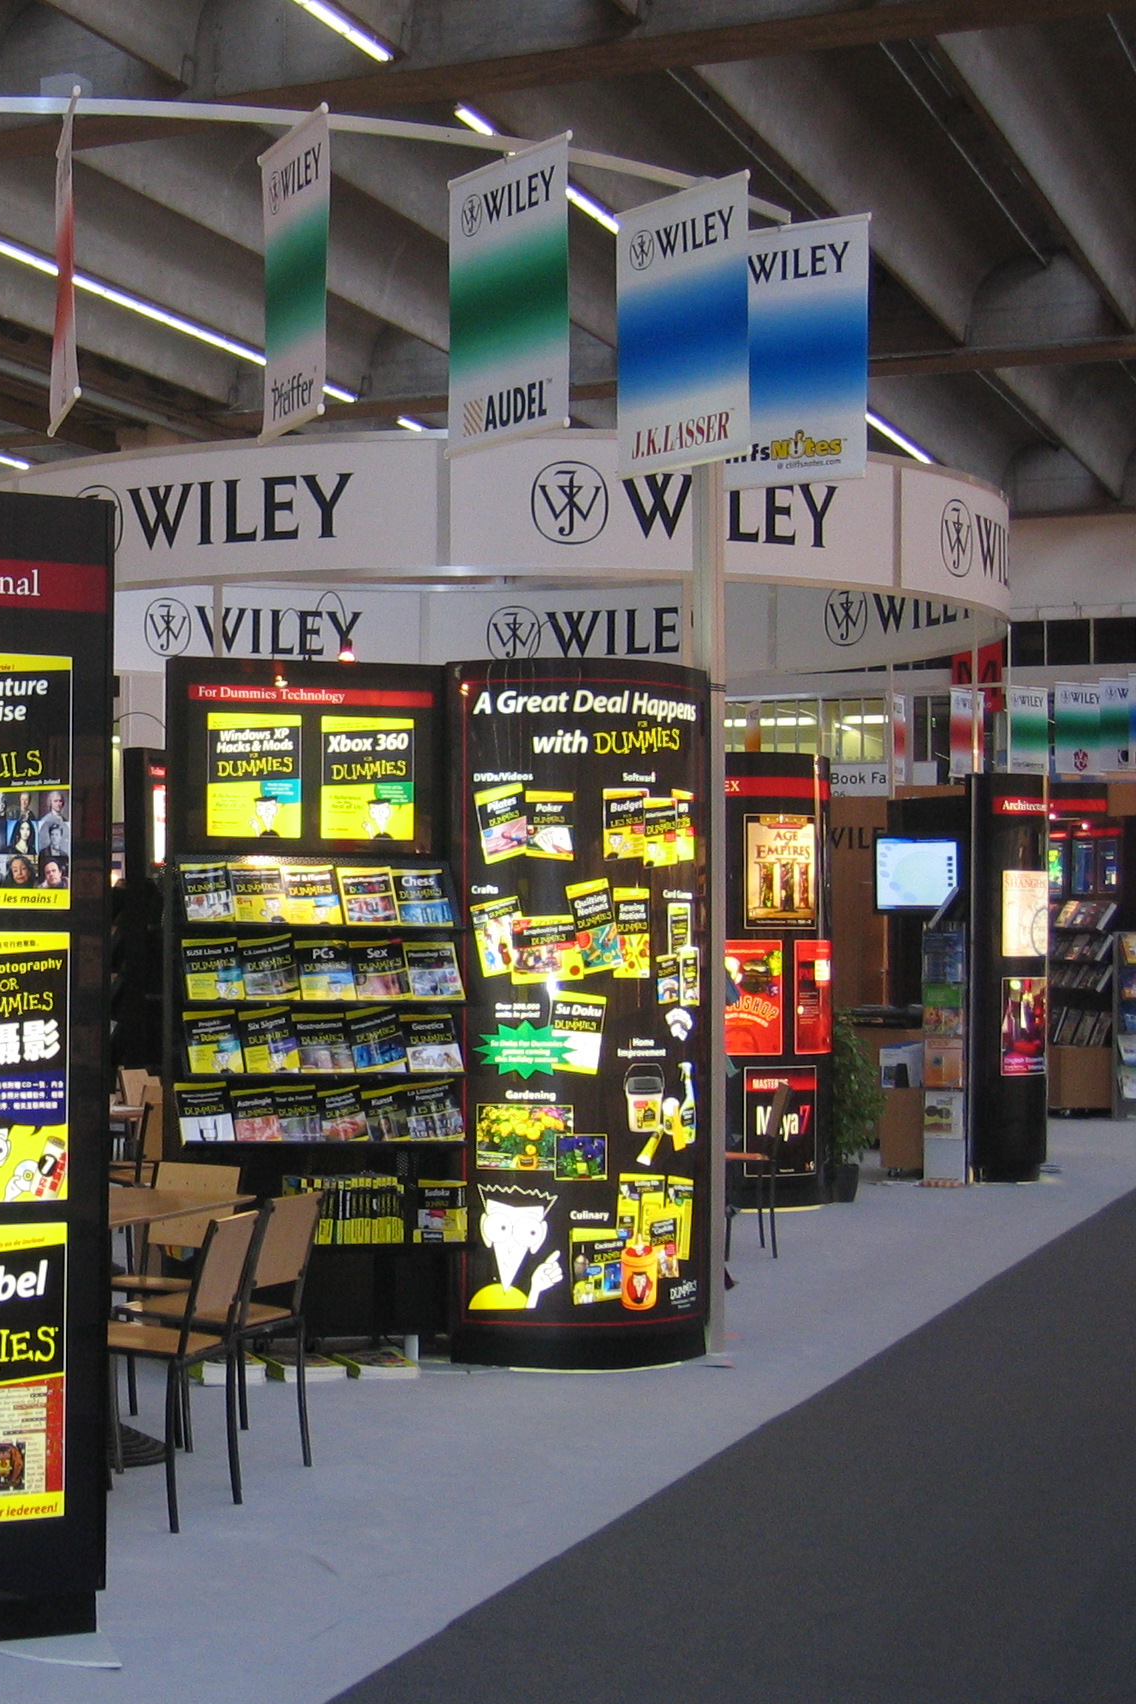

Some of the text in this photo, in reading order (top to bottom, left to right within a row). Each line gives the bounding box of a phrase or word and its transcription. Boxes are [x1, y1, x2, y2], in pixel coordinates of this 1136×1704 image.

[280, 142, 322, 201] WILEY
[483, 165, 556, 225] WILEY
[655, 205, 735, 261] WILEY
[748, 241, 850, 285] WILEY
[271, 371, 315, 422] Pfeiffer
[484, 379, 548, 432] AUDEL
[126, 472, 355, 551] WILEY
[621, 472, 838, 549] WLEY
[195, 604, 364, 657] WILEY
[544, 605, 683, 658] WILE
[198, 686, 345, 704] For Dummies Technology
[1018, 695, 1044, 709] WILEY
[1070, 690, 1100, 706] WILEY
[473, 690, 697, 723] A Great Deal Happens
[219, 727, 290, 742] Windows XP
[532, 727, 681, 755] with DUMMIES
[216, 739, 294, 753] Hacks & Mods
[327, 733, 409, 754] Xbox 360
[216, 756, 294, 777] DUMMIES
[330, 760, 407, 780] DUMMIES
[473, 772, 534, 783] DVDs/Videos
[622, 772, 656, 783] Softwar
[831, 771, 887, 786] Book Fa
[724, 780, 741, 792] EX
[486, 797, 517, 813] Pilates
[535, 803, 563, 813] Poker
[610, 800, 643, 813] Budget
[488, 810, 521, 827] DUMMIES
[773, 830, 799, 842] AGE
[755, 843, 811, 860] EMPIRES
[401, 876, 435, 887] Chess
[471, 885, 499, 895] Crafts
[2, 892, 18, 904] les
[19, 893, 52, 904] mains
[574, 893, 608, 910] Quilting
[577, 902, 609, 918] Notions
[619, 903, 645, 913] Sewing
[619, 911, 647, 920] Notions
[312, 948, 335, 960] PCs
[366, 947, 388, 959] Sex
[555, 1003, 603, 1017] Su Doku
[247, 1017, 286, 1031] Six Sigma
[411, 1021, 444, 1031] Genetics
[554, 1019, 597, 1031] DUMMIES
[632, 1037, 655, 1047] Home
[617, 1048, 667, 1058] Improvement
[505, 1090, 556, 1102] Gardening
[756, 1104, 811, 1142] Mya 7
[569, 1210, 610, 1221] Culinary
[6, 1502, 58, 1516] iedereen!
